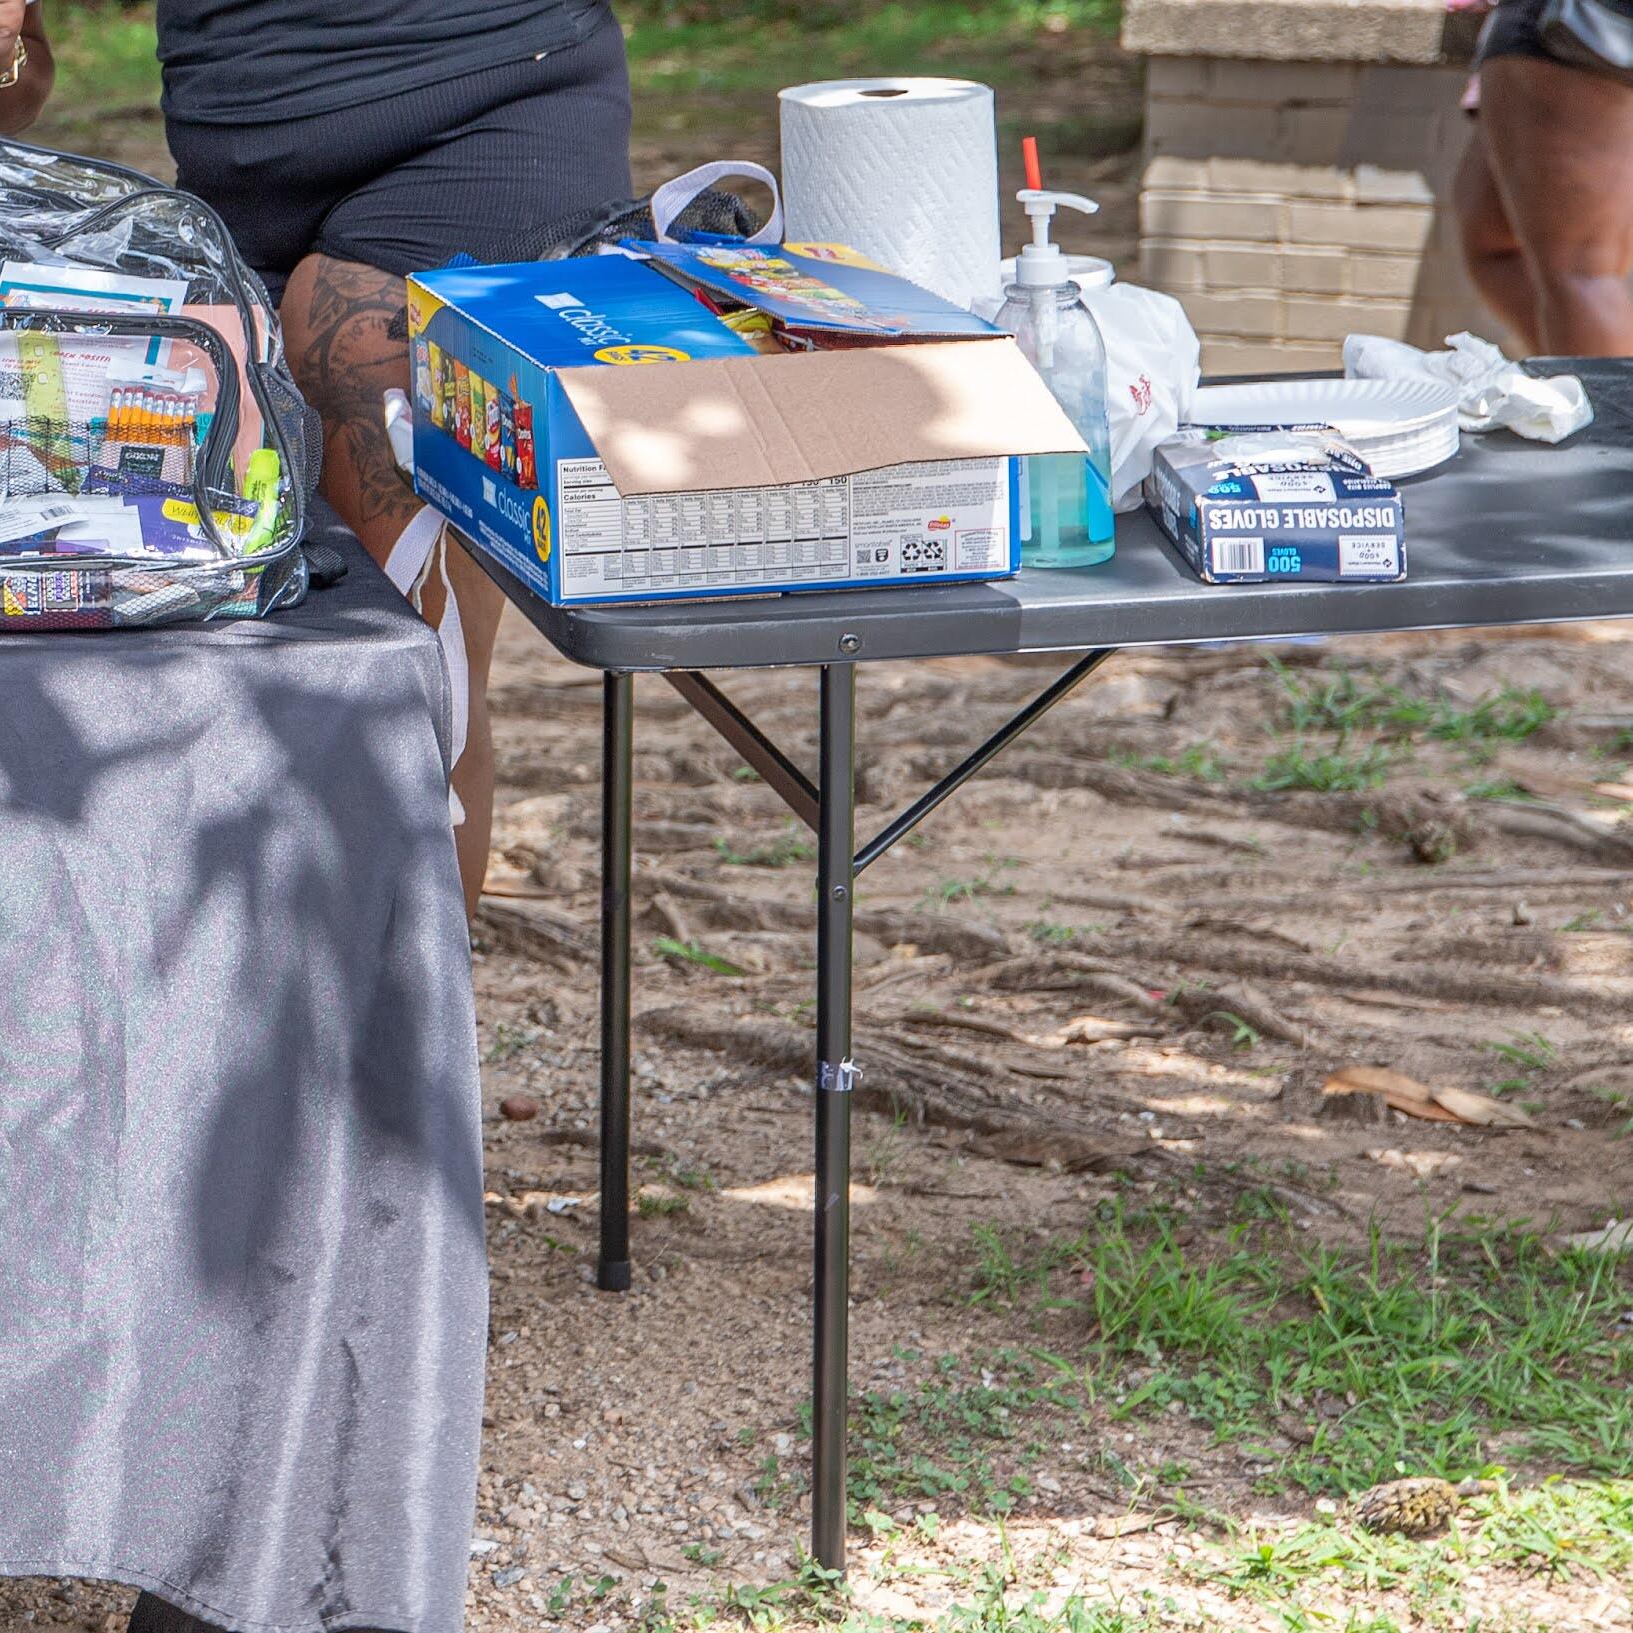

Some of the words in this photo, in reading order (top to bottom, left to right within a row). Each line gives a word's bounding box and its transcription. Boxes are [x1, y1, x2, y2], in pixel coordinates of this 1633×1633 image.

[558, 309, 633, 345] classic
[563, 465, 597, 473] Nutrition
[563, 493, 596, 501] Calories
[498, 487, 531, 534] classic
[1209, 508, 1280, 530] GLOVES
[1284, 507, 1395, 529] DISPOSABLE
[1271, 548, 1297, 556] GLOVES
[1268, 556, 1301, 573] 500
